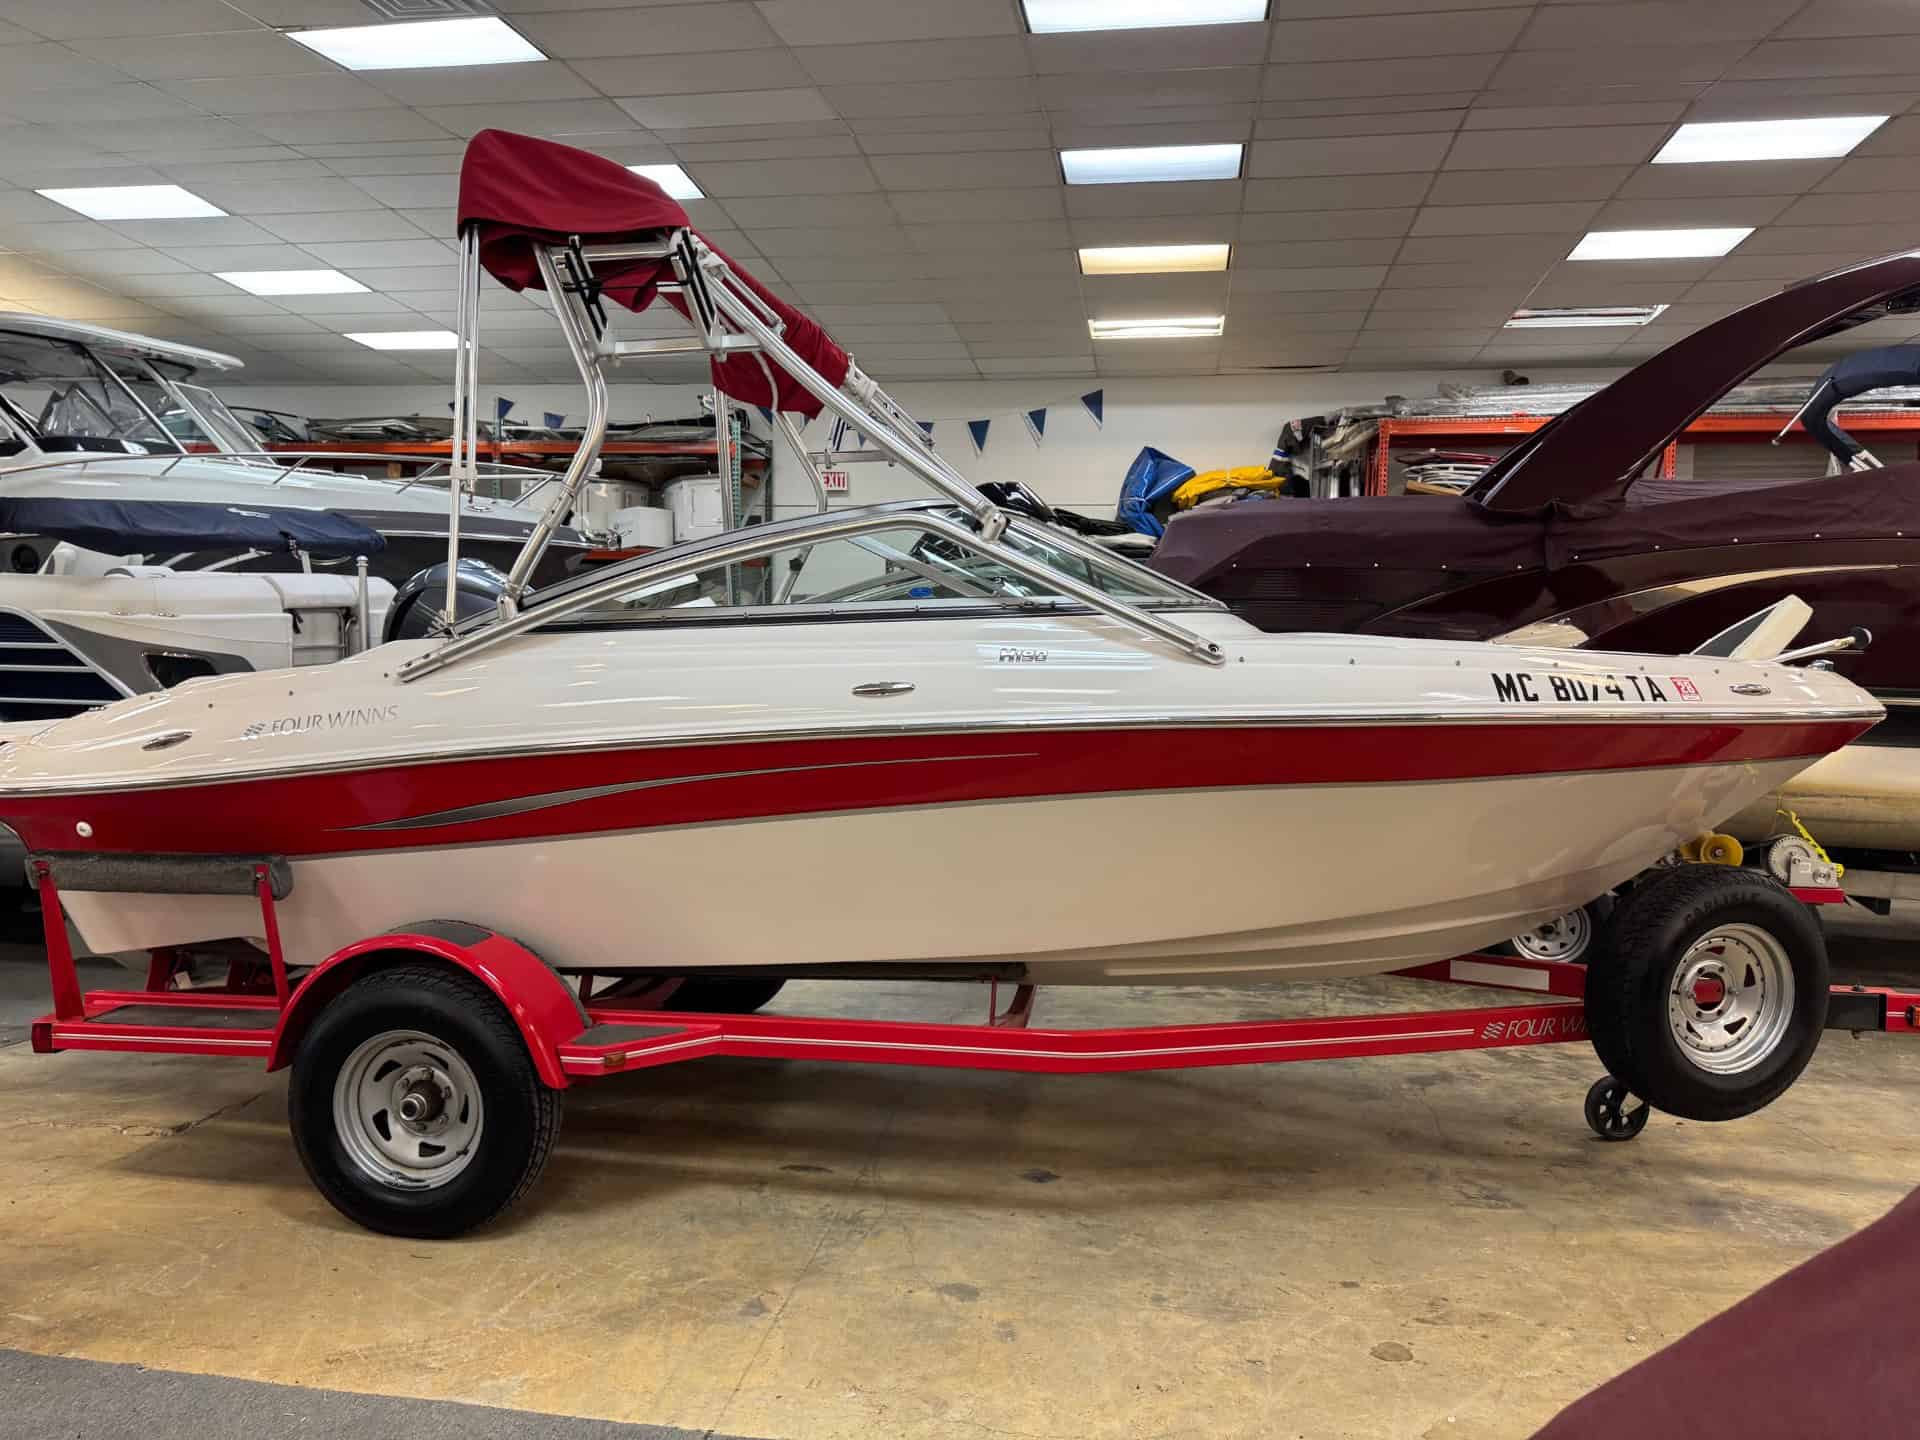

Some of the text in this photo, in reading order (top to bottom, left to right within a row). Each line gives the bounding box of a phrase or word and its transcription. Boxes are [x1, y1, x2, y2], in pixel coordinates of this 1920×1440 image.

[821, 473, 847, 489] EXIT
[1491, 673, 1539, 702] MC
[1625, 675, 1667, 701] TA
[271, 704, 399, 733] FOUR WINNS
[1505, 1018, 1555, 1039] FOUR
